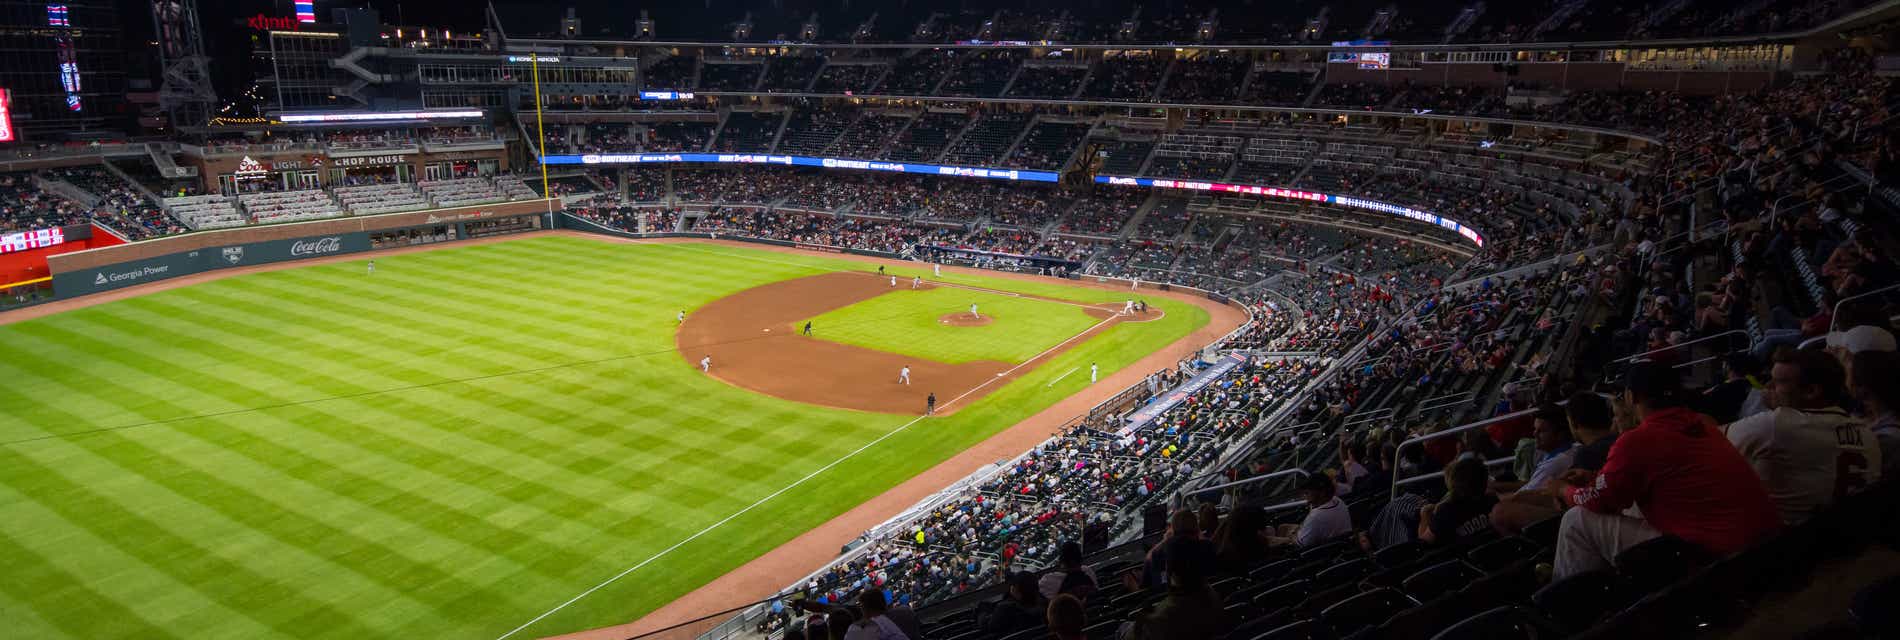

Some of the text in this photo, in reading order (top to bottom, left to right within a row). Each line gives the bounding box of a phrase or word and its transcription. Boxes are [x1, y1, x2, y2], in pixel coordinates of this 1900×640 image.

[248, 13, 298, 32] xfinity
[272, 160, 302, 170] LIGHT
[335, 155, 406, 167] CHOP HOUSE
[109, 264, 169, 283] Georgia Power
[1835, 424, 1864, 446] COX
